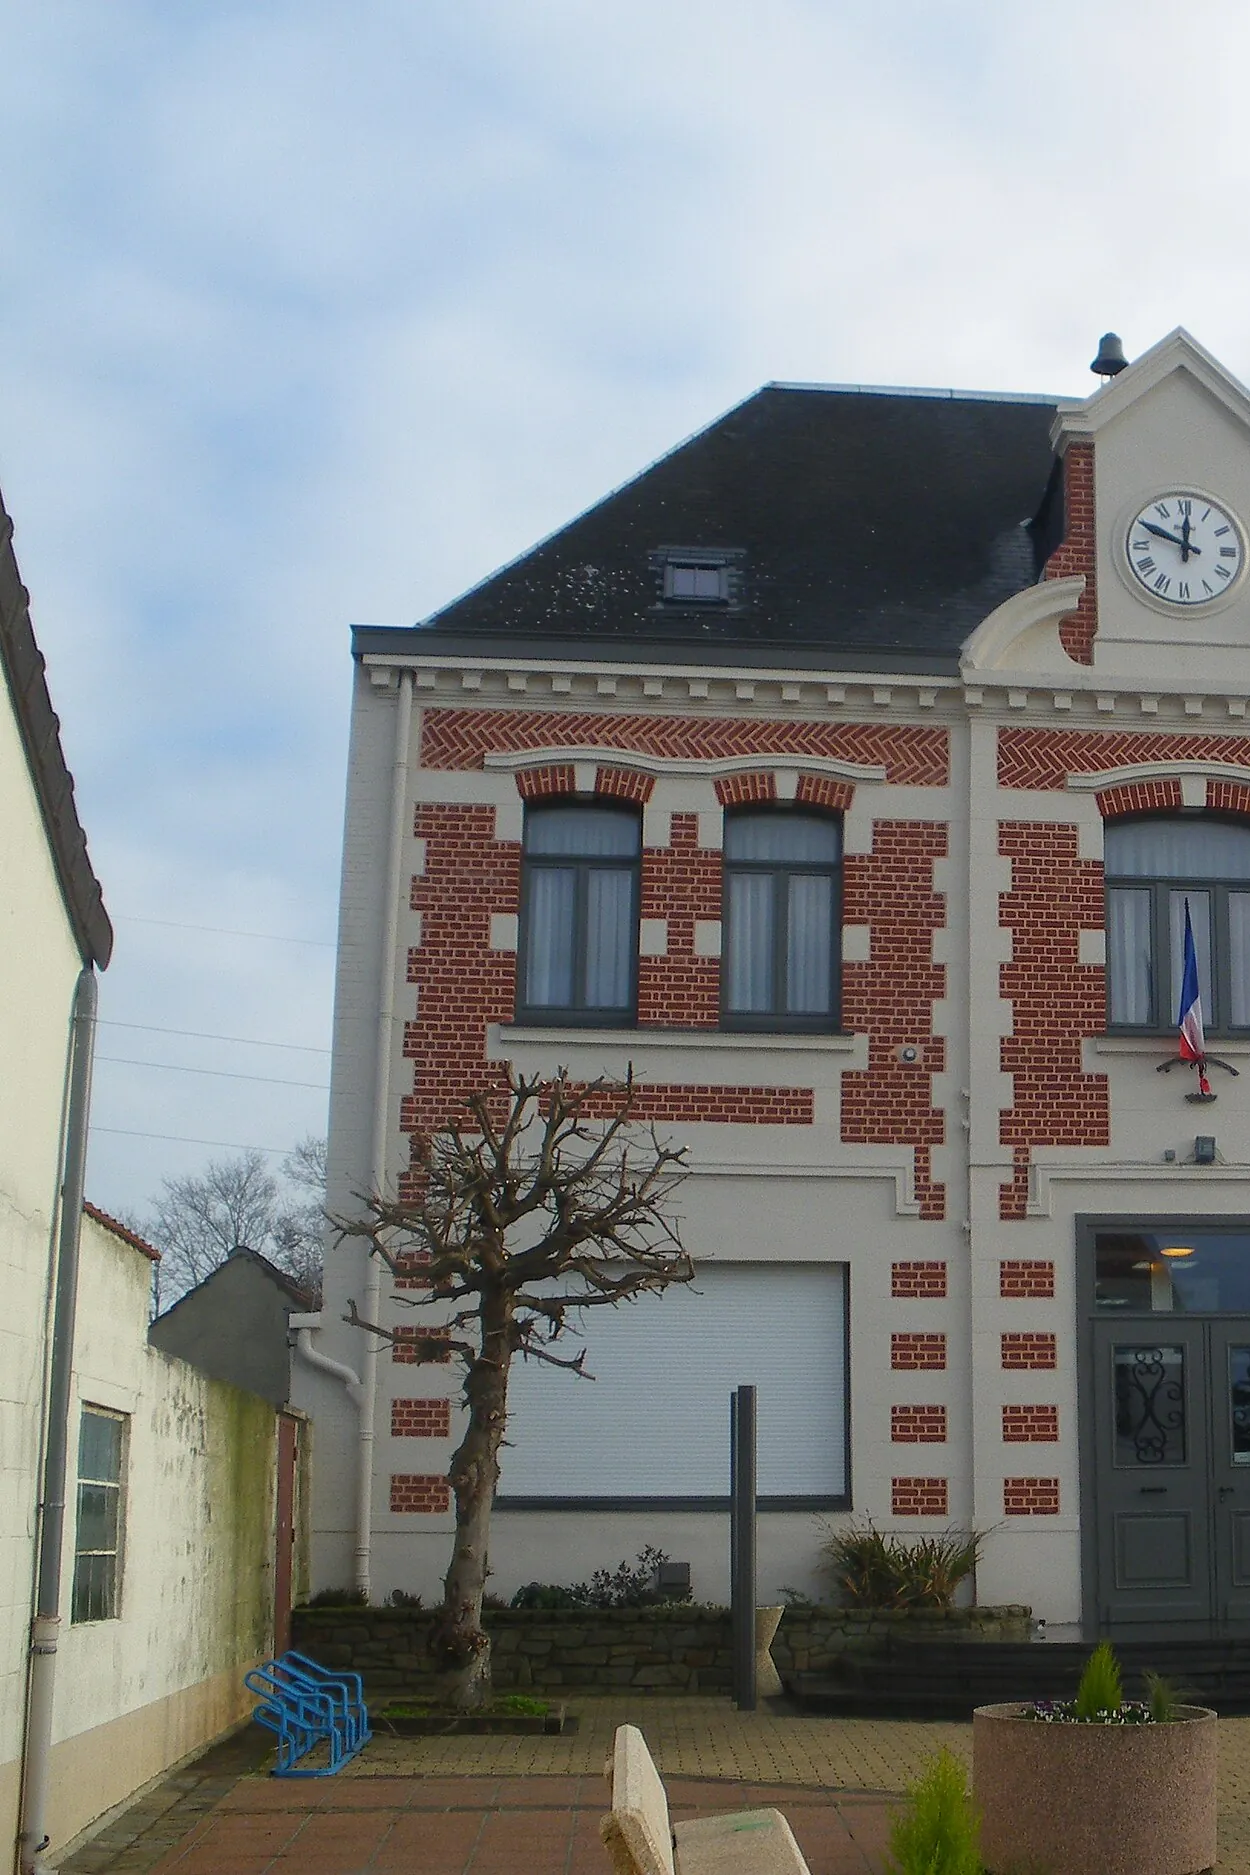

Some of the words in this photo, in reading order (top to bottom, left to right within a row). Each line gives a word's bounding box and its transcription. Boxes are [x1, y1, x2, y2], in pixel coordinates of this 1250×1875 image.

[1154, 502, 1170, 520] XI
[1177, 500, 1192, 516] XII
[1214, 525, 1230, 537] II
[1132, 540, 1150, 551] IX
[1219, 547, 1236, 557] III
[1136, 556, 1157, 578] VIII
[1153, 573, 1172, 594] VII
[1179, 581, 1190, 599] VI
[1201, 579, 1213, 595] V
